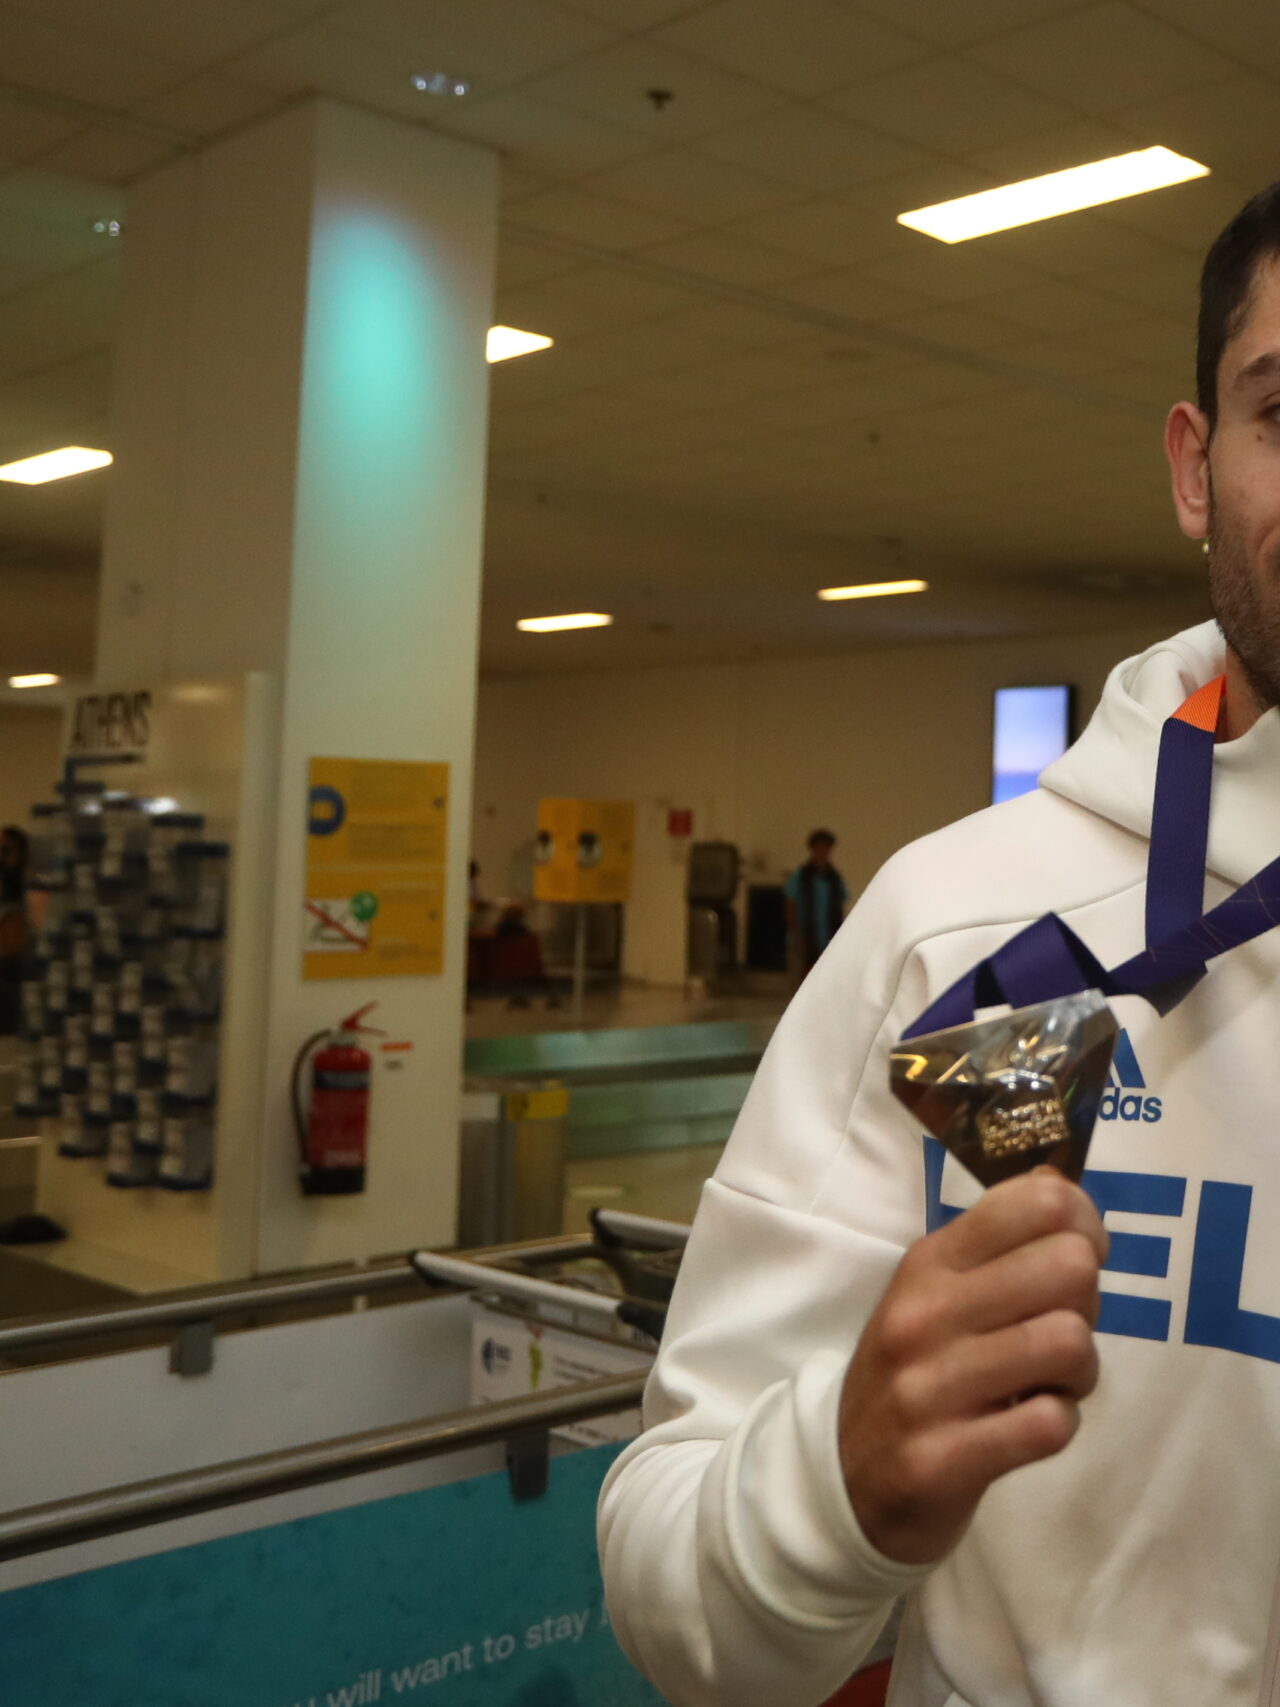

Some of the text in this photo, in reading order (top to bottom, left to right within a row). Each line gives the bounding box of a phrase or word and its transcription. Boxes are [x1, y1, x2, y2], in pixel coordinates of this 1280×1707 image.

[1097, 1086, 1163, 1123] das
[326, 1607, 588, 1707] will want to stay
